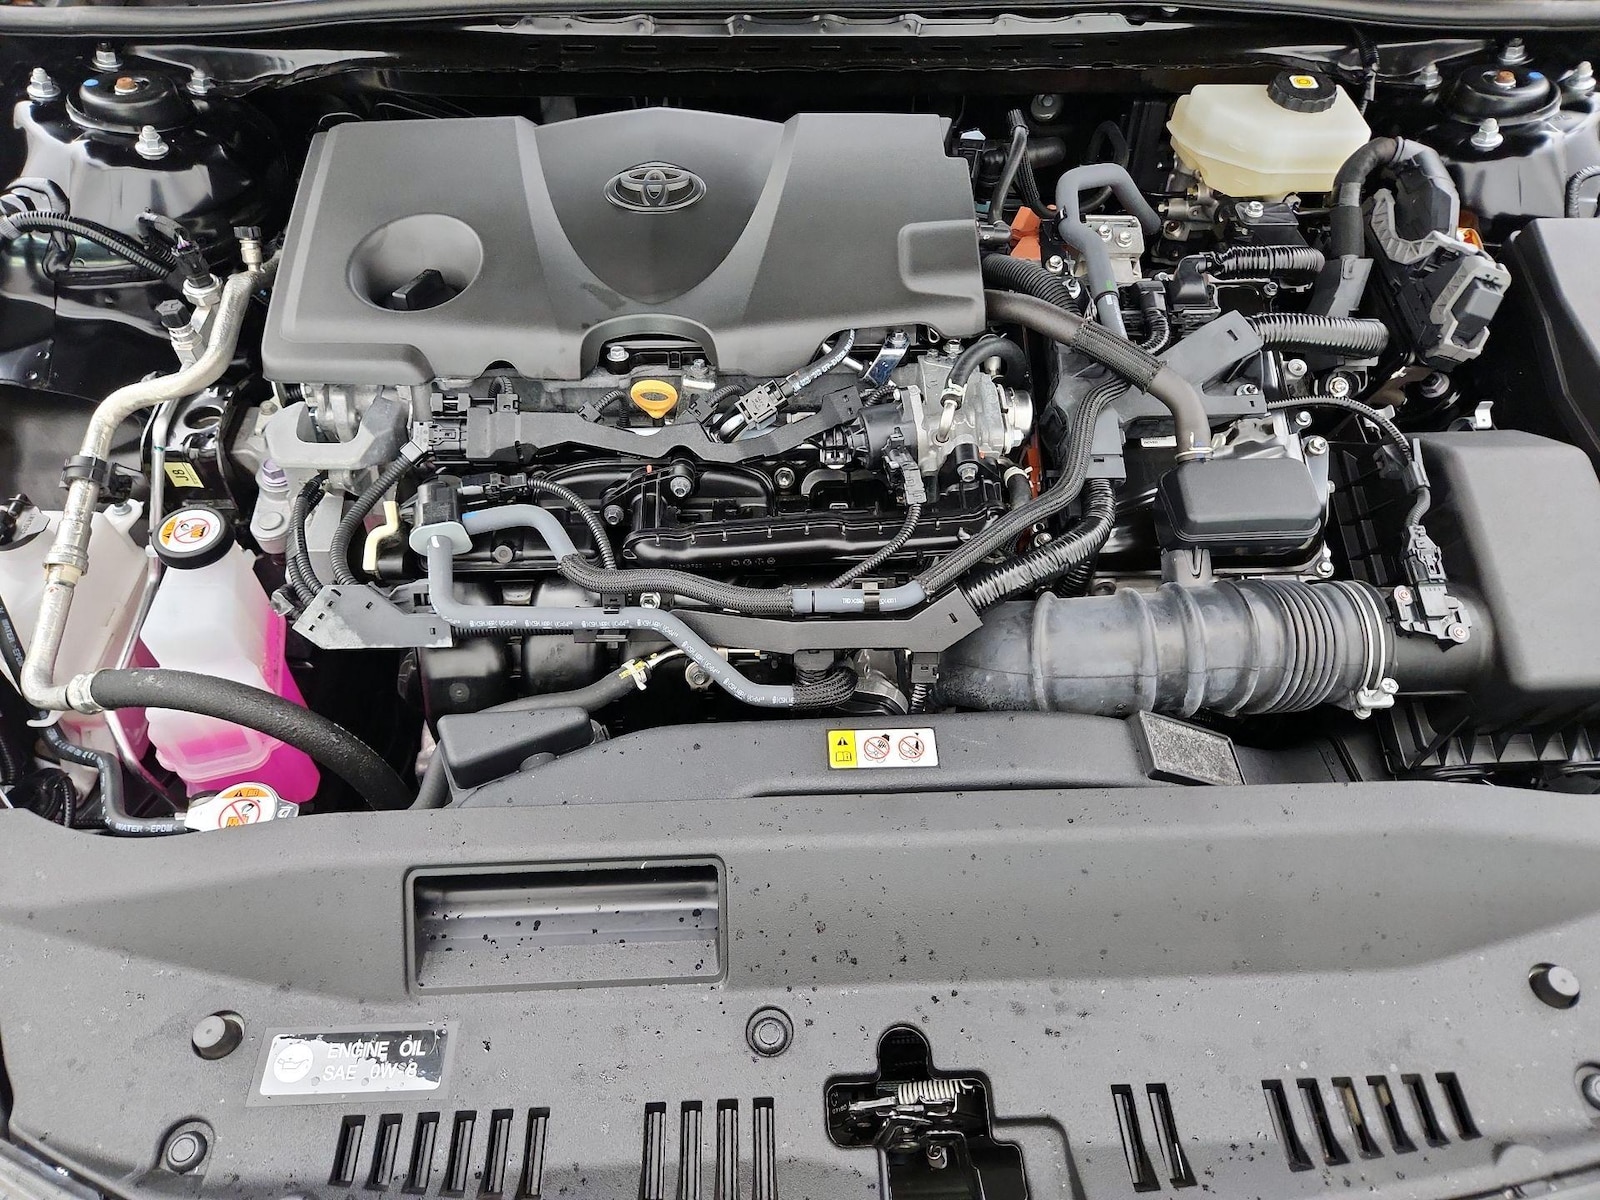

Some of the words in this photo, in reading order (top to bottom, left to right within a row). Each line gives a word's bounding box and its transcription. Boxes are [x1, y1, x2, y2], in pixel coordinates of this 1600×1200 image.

[1, 618, 16, 643] WATER
[115, 822, 143, 833] WATER
[327, 1040, 390, 1058] ENGINE
[399, 1039, 426, 1056] OIL
[322, 1064, 357, 1081] SAE
